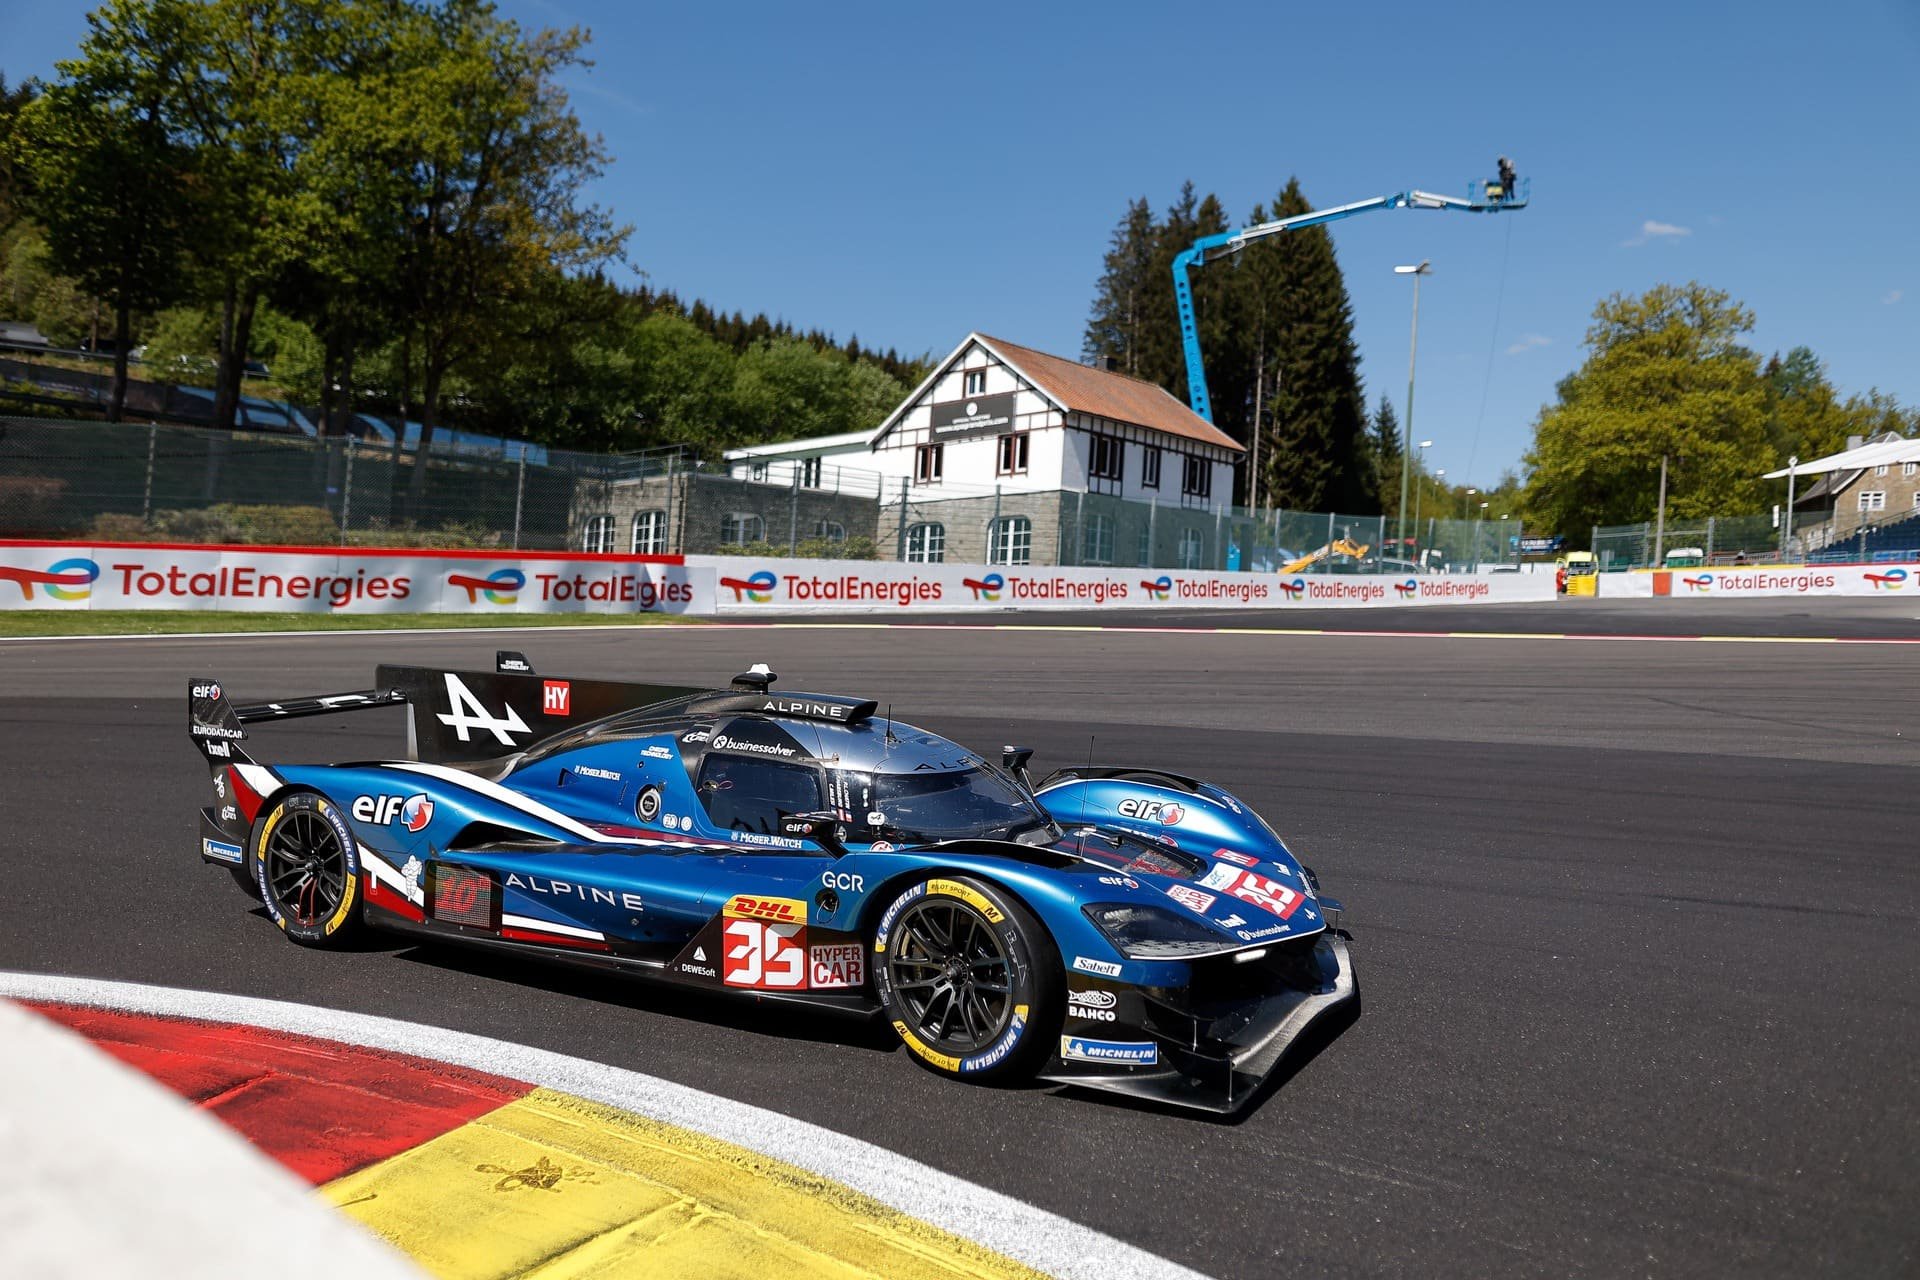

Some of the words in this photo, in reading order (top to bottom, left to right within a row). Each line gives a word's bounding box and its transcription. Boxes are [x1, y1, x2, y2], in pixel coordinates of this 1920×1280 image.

[112, 564, 411, 607] TotalEnergies
[783, 575, 942, 606] TotalEnergies
[1008, 577, 1128, 603] TotalEnergies
[1175, 578, 1268, 602] TotalEnergies
[1307, 581, 1385, 602] TotalEnergies
[1420, 579, 1489, 600] TotalEnergies
[1717, 571, 1835, 592] TotalEnergies
[192, 685, 211, 698] elf
[545, 686, 568, 710] HY
[763, 701, 842, 717] ALPINE
[192, 725, 243, 739] EURODATACAR
[206, 740, 231, 758] ixell
[727, 737, 796, 757] businessolver
[352, 794, 404, 826] elf
[1117, 798, 1161, 820] elf
[786, 823, 801, 833] elf
[330, 813, 355, 869] MICHELIN
[740, 832, 803, 849] MOSER.WATCH
[213, 846, 241, 858] MICHELIN
[822, 871, 865, 893] GCR
[950, 885, 971, 898] SPORT
[1098, 876, 1123, 886] elf
[505, 872, 644, 912] ALPINE
[735, 897, 795, 921] DHL
[883, 885, 921, 930] MICHELIN
[984, 906, 998, 919] M
[725, 920, 803, 986] 35
[814, 945, 861, 961] HYPER
[682, 963, 716, 977] DEWESoft
[814, 961, 862, 985] CAR
[1079, 959, 1116, 975] Sabelt
[1069, 1005, 1116, 1022] BAHCO
[966, 1029, 1017, 1071] MICHELIN
[1087, 1046, 1155, 1059] MICHELIN
